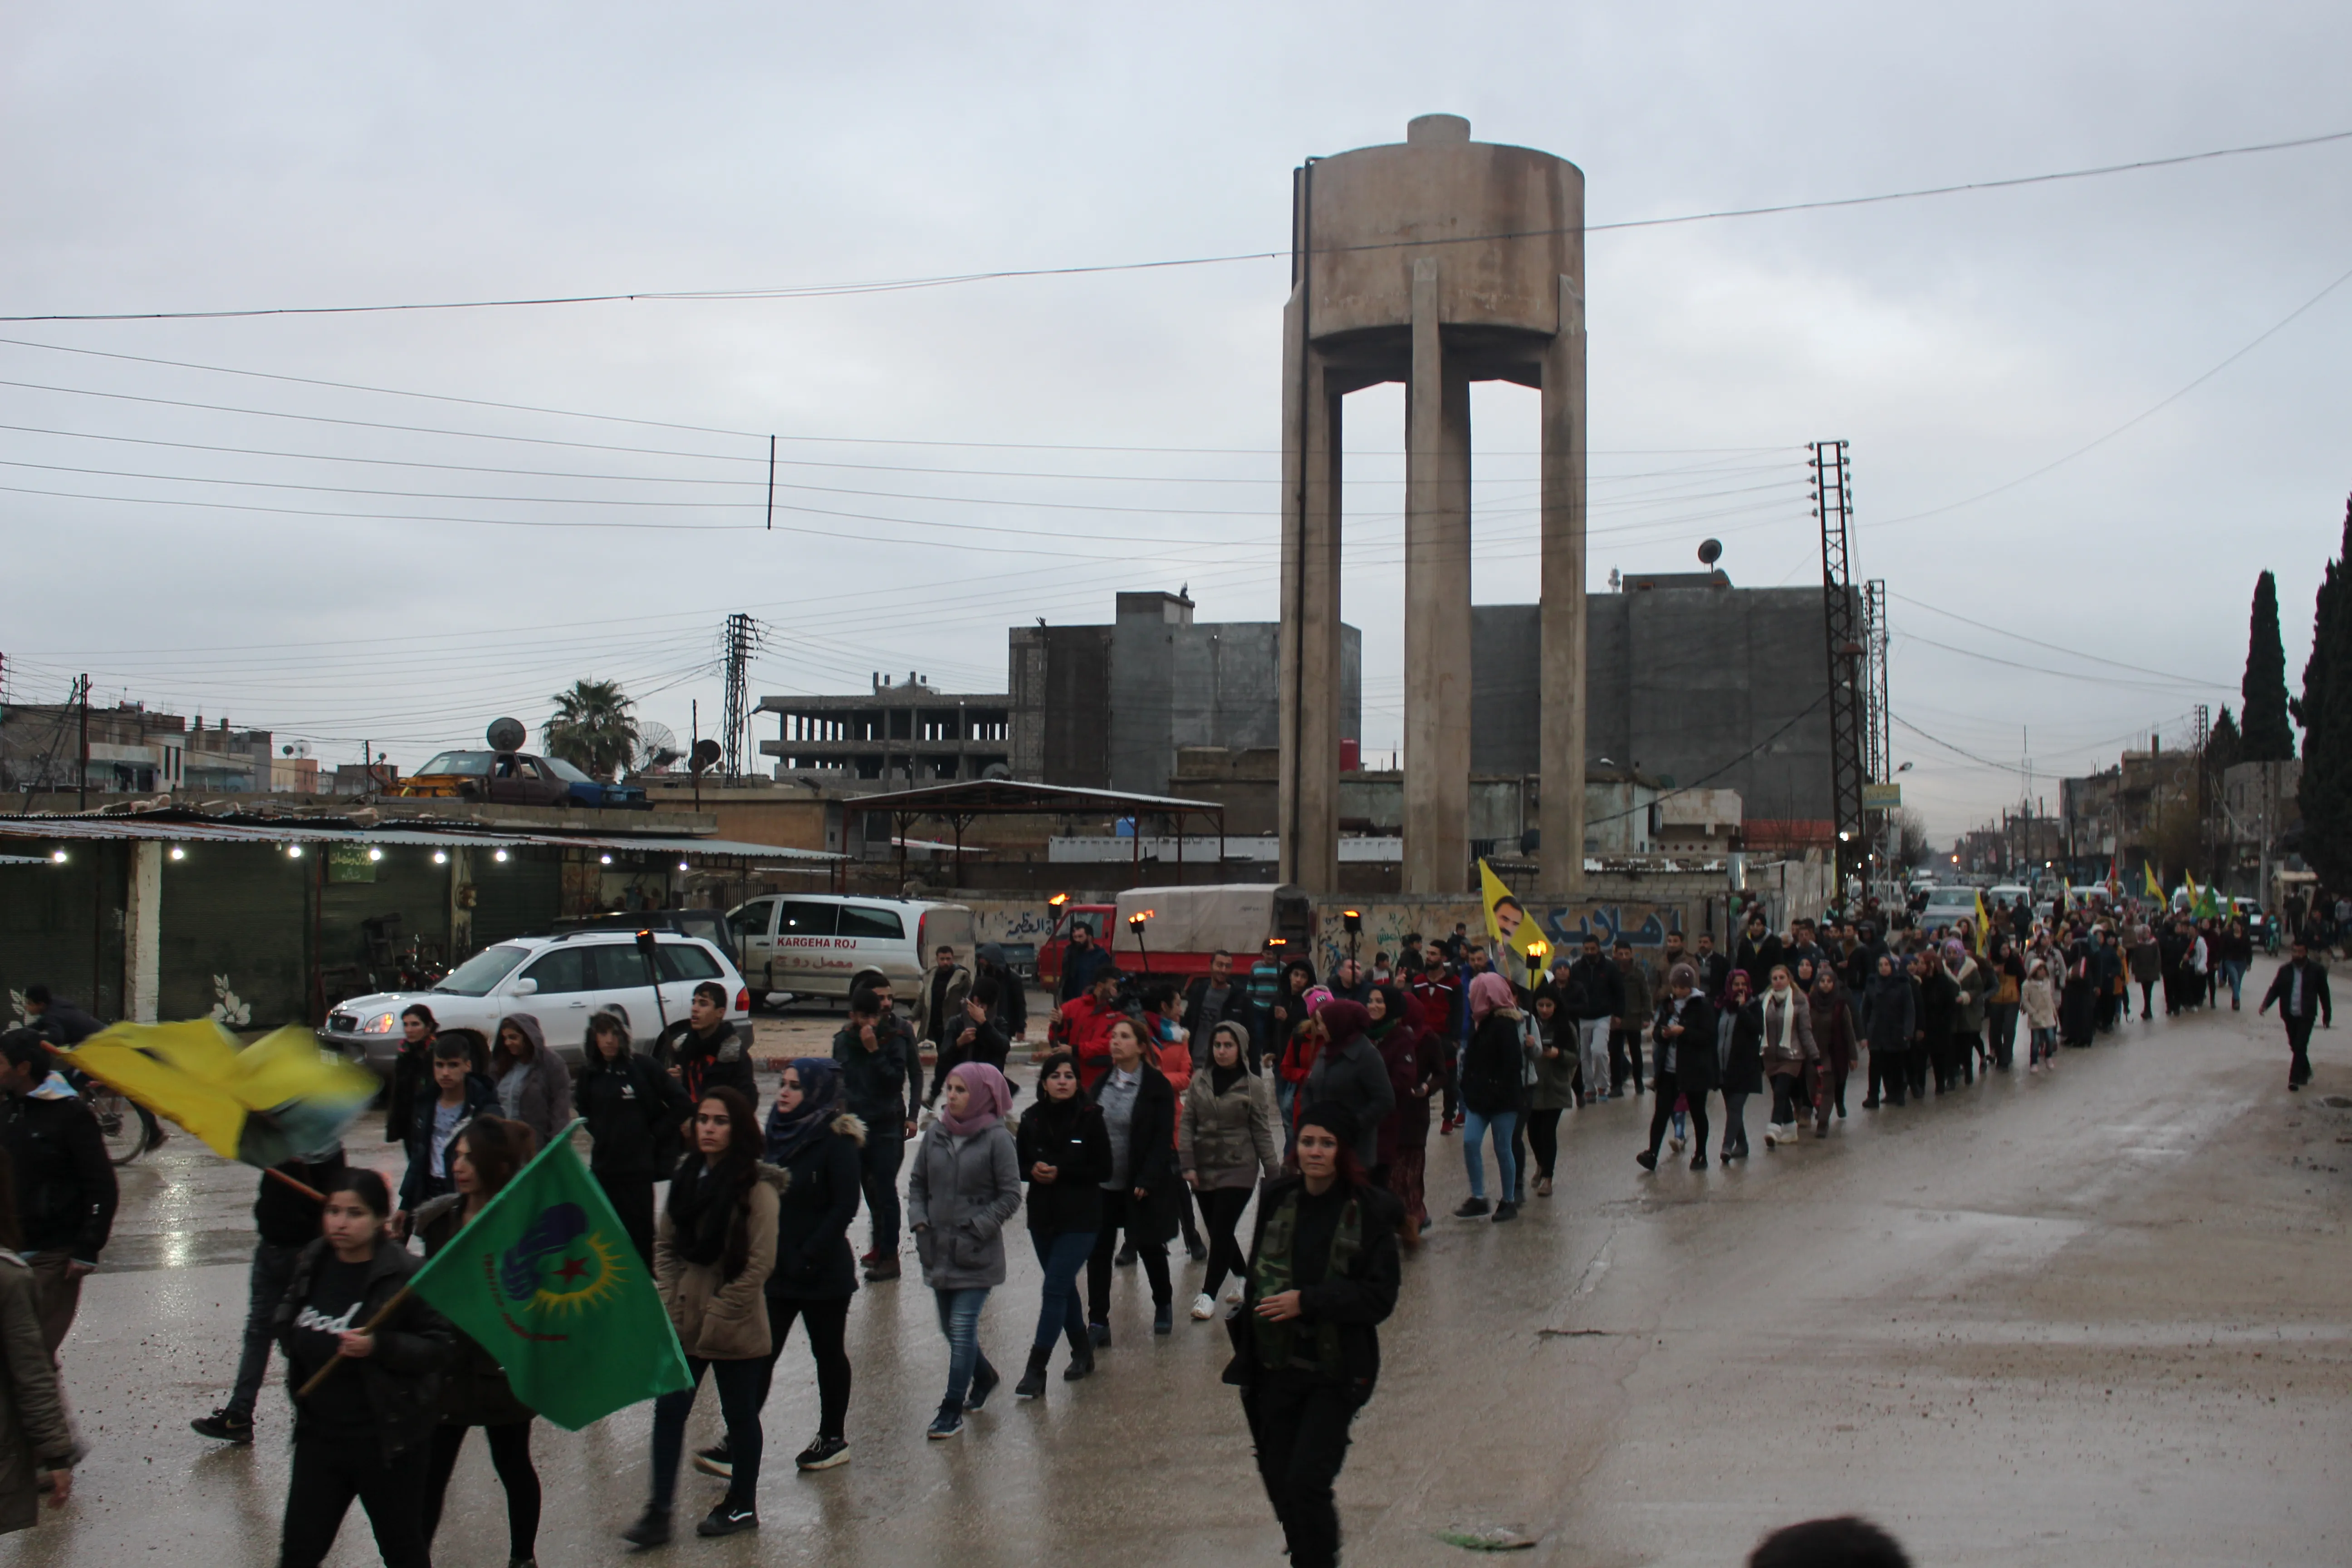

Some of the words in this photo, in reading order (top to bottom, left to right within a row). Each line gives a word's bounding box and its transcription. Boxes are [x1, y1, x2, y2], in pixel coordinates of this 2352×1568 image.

[777, 937, 830, 948] KARGEHA
[834, 939, 857, 950] ROJ
[812, 956, 853, 970] معمل
